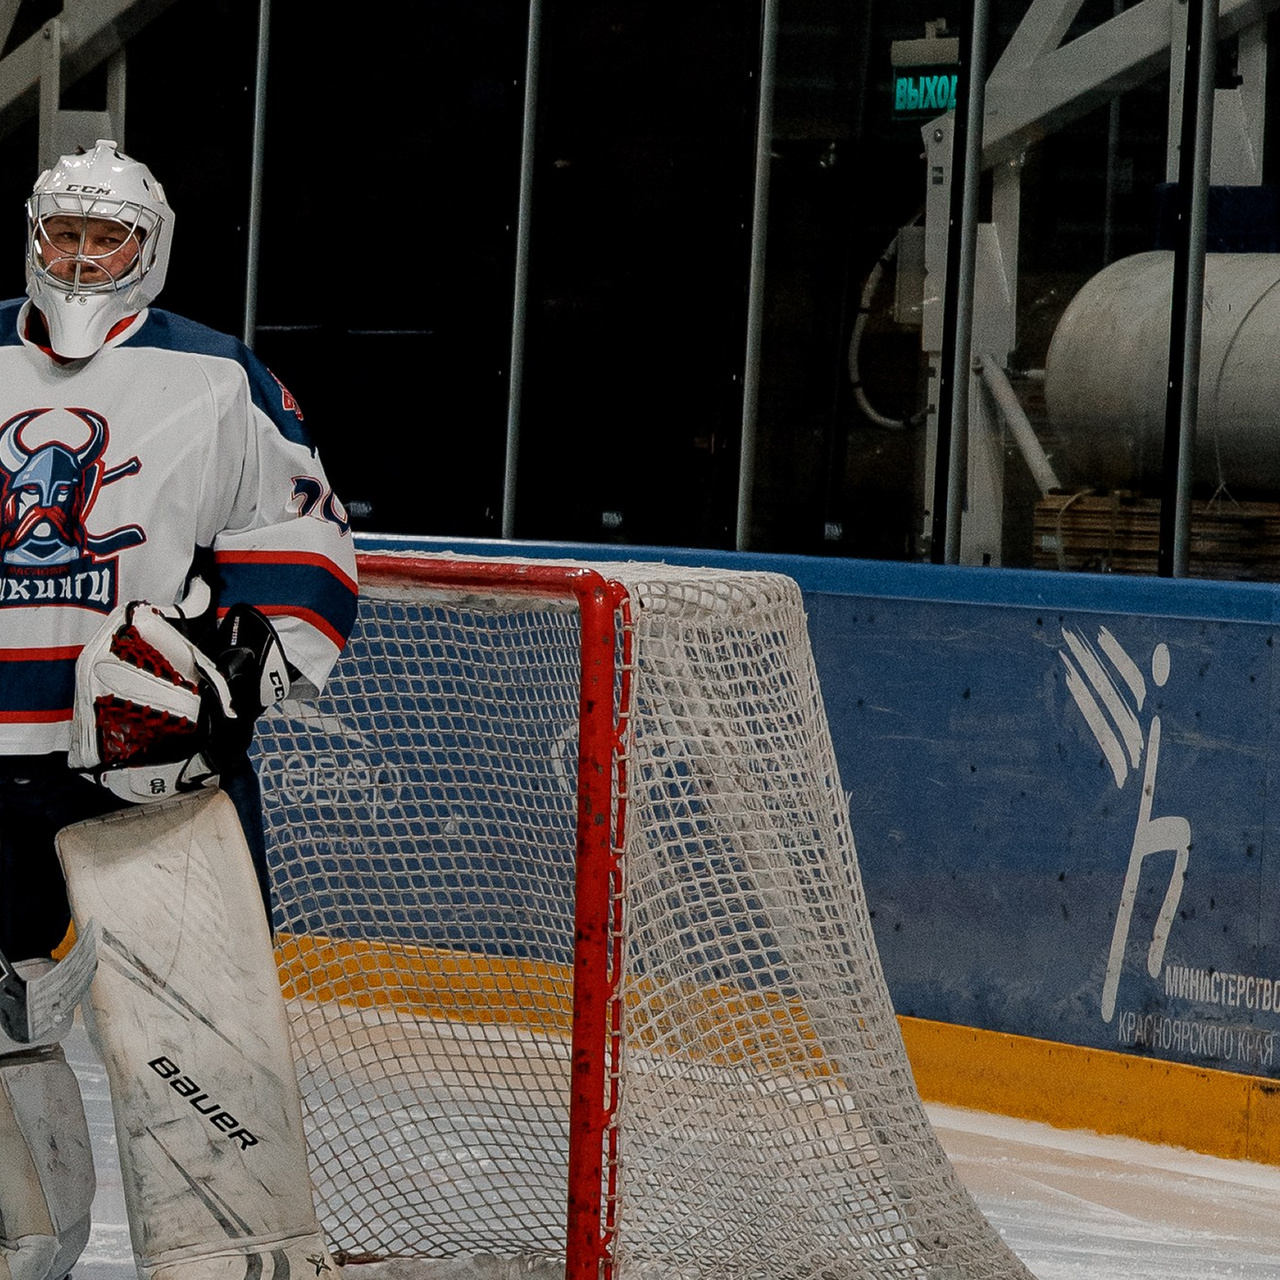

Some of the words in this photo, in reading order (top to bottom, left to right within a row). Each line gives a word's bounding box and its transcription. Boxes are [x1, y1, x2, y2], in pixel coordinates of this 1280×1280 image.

[65, 184, 111, 196] CCM
[1165, 965, 1280, 1013] МИНИСТЕРСТВО
[1118, 1011, 1234, 1060] КРАСНОЯРСКОГО
[1238, 1031, 1275, 1066] КРАЯ
[147, 1055, 259, 1151] BAUER
